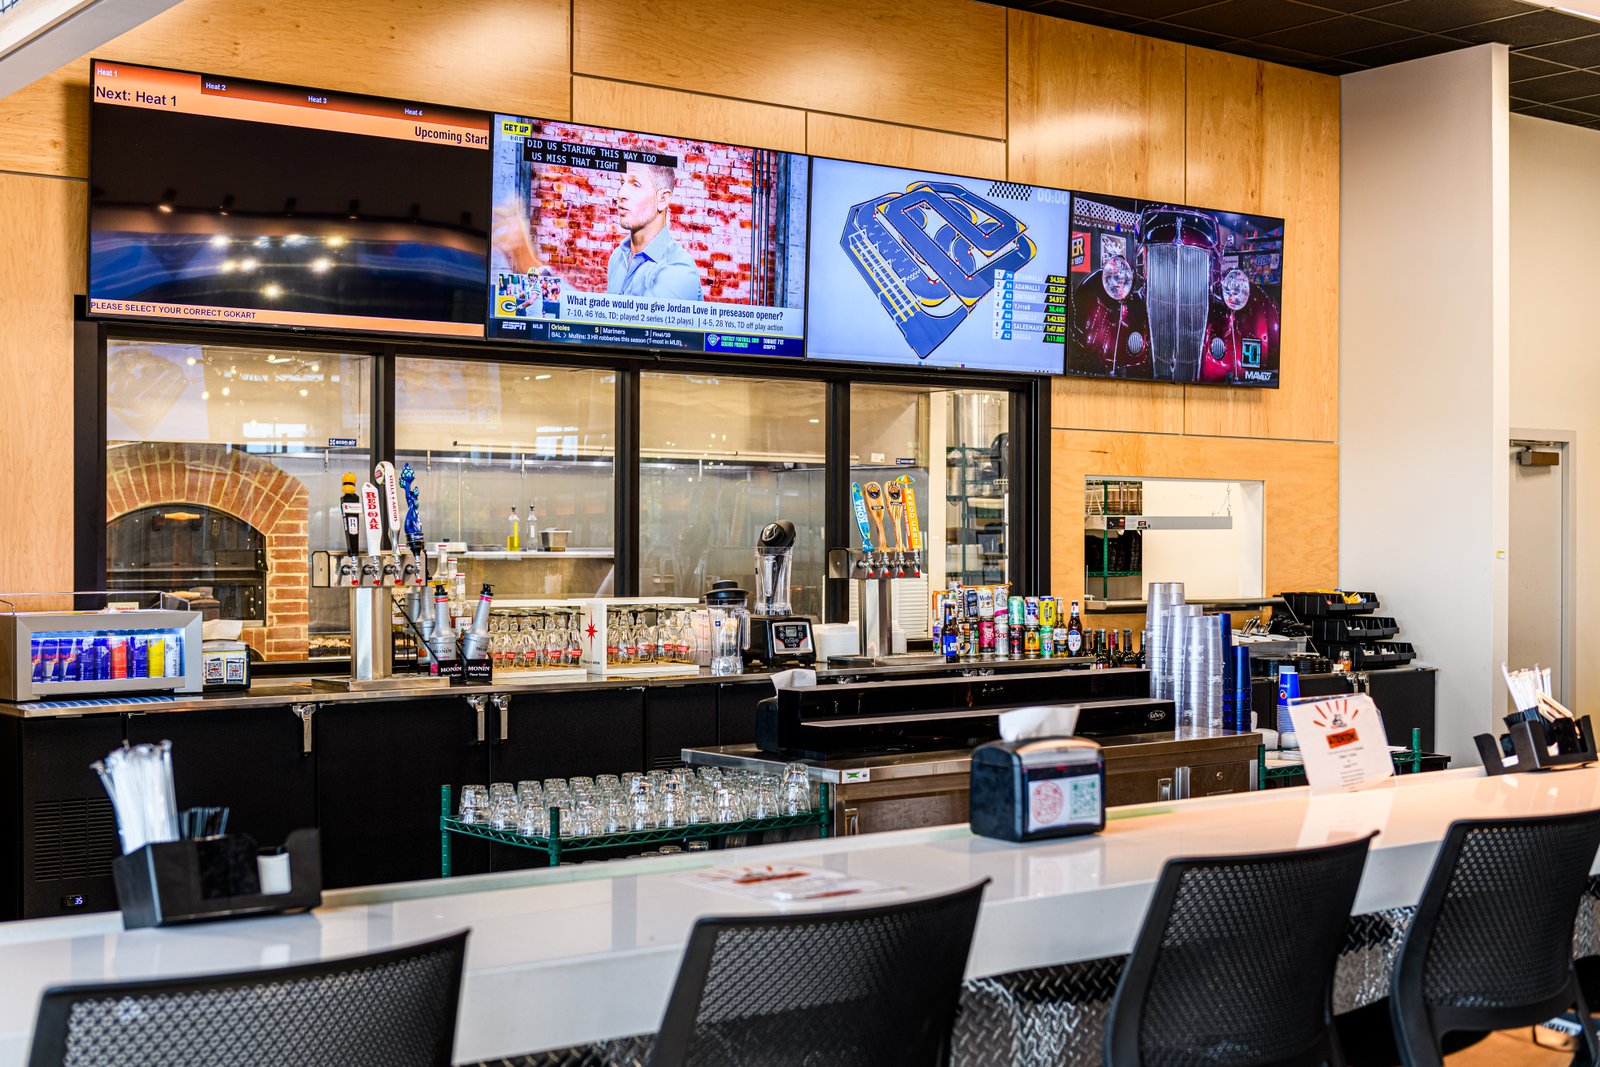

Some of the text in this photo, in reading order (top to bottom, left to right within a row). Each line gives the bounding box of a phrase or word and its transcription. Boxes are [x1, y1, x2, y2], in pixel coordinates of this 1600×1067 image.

[97, 68, 112, 76] Heat
[205, 82, 220, 90] Heat
[96, 86, 177, 106] Next: Heat 1
[308, 95, 321, 103] Heat
[404, 108, 418, 116] Heat
[504, 123, 518, 131] GET
[414, 125, 488, 145] Upcoming Start
[527, 140, 657, 163] DID US STARING THIS WAY TOO
[531, 152, 619, 170] US MISS THAT TIGHT
[1037, 189, 1068, 205] 00:00
[91, 302, 256, 319] PLEASE SELECT YOUR CORRECT GOKART
[567, 295, 783, 320] What grade would you give Jordan Love in preseason opener?
[567, 309, 583, 318] 7-10,
[594, 311, 607, 319] Yds,
[620, 313, 639, 322] played
[646, 315, 663, 323] series
[664, 316, 676, 324] (12
[677, 317, 694, 326] plays)
[502, 321, 526, 330] ESPN
[602, 327, 626, 335] Mariners
[715, 319, 723, 327] 28
[754, 323, 766, 331] play
[767, 323, 784, 331] action
[646, 337, 664, 345] (T-most
[365, 492, 377, 509] RED
[906, 490, 916, 518] MANGO
[911, 520, 919, 544] CART
[74, 896, 84, 905] 35
